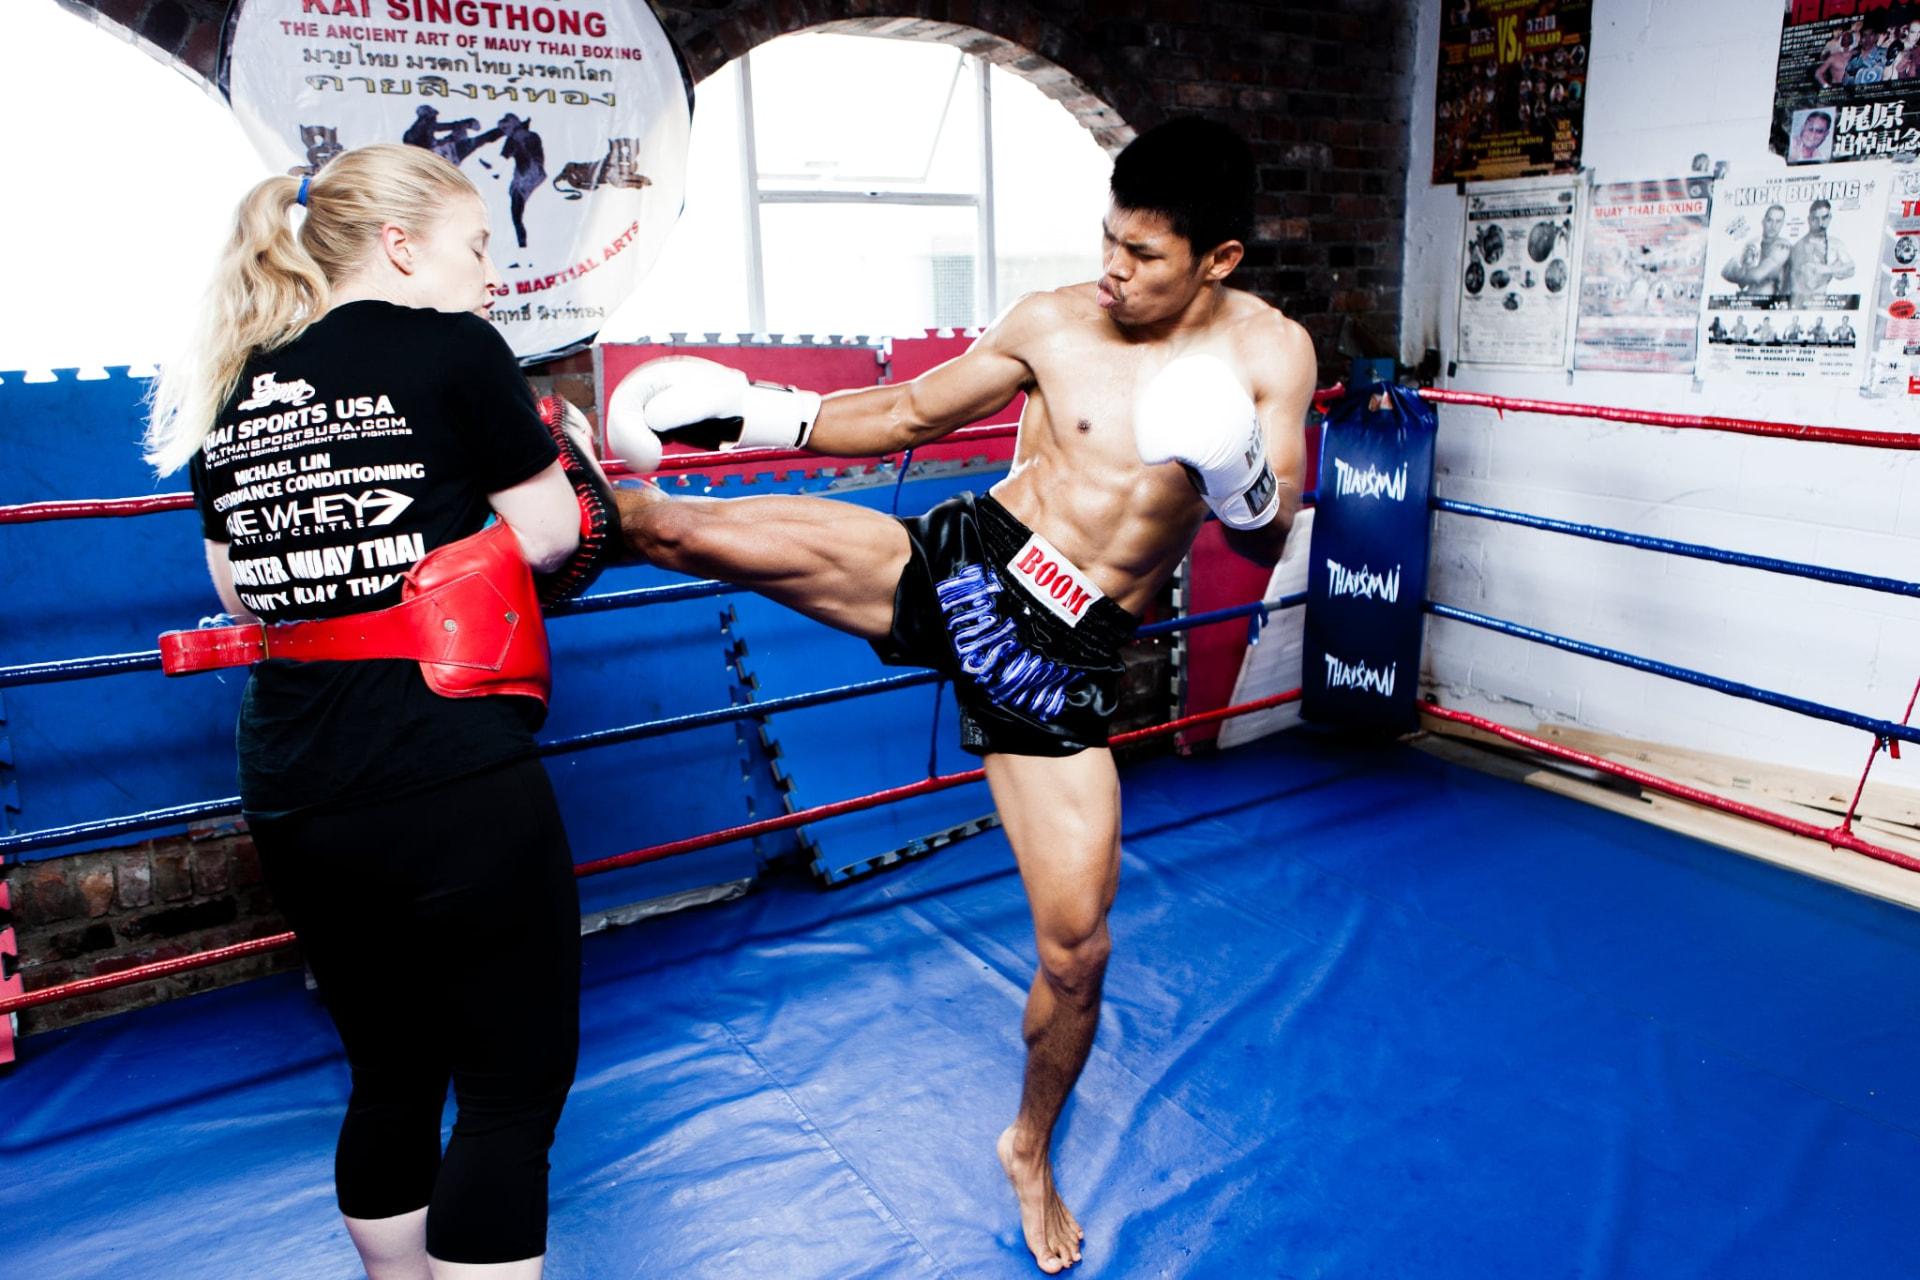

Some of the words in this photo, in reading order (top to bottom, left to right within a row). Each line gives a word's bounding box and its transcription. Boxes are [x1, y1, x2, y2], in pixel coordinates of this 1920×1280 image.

[387, 0, 607, 38] SINGTHONG
[280, 20, 319, 37] THE
[326, 24, 408, 44] ANCIENT
[415, 31, 449, 47] ART
[456, 34, 478, 49] OF
[484, 36, 531, 53] MAUY
[537, 41, 575, 57] THAI
[582, 45, 642, 61] BOXING
[1594, 206, 1623, 218] MUAY
[1627, 204, 1654, 216] THAI
[1657, 201, 1703, 215] BOXING
[1734, 186, 1782, 207] KICK
[1785, 179, 1861, 203] BOXING
[515, 258, 600, 295] MARTIAL
[602, 220, 639, 261] ARTS
[238, 403, 328, 440] SPORTS
[335, 394, 396, 419] USA
[234, 459, 297, 486] MICHAEL
[300, 453, 331, 472] LIN
[285, 463, 425, 493] CONDITIONING
[261, 490, 375, 531] WHEY
[290, 519, 365, 537] CENTRE
[286, 545, 354, 579] MUAY
[358, 533, 426, 569] THAI
[1016, 545, 1092, 617] BOOM
